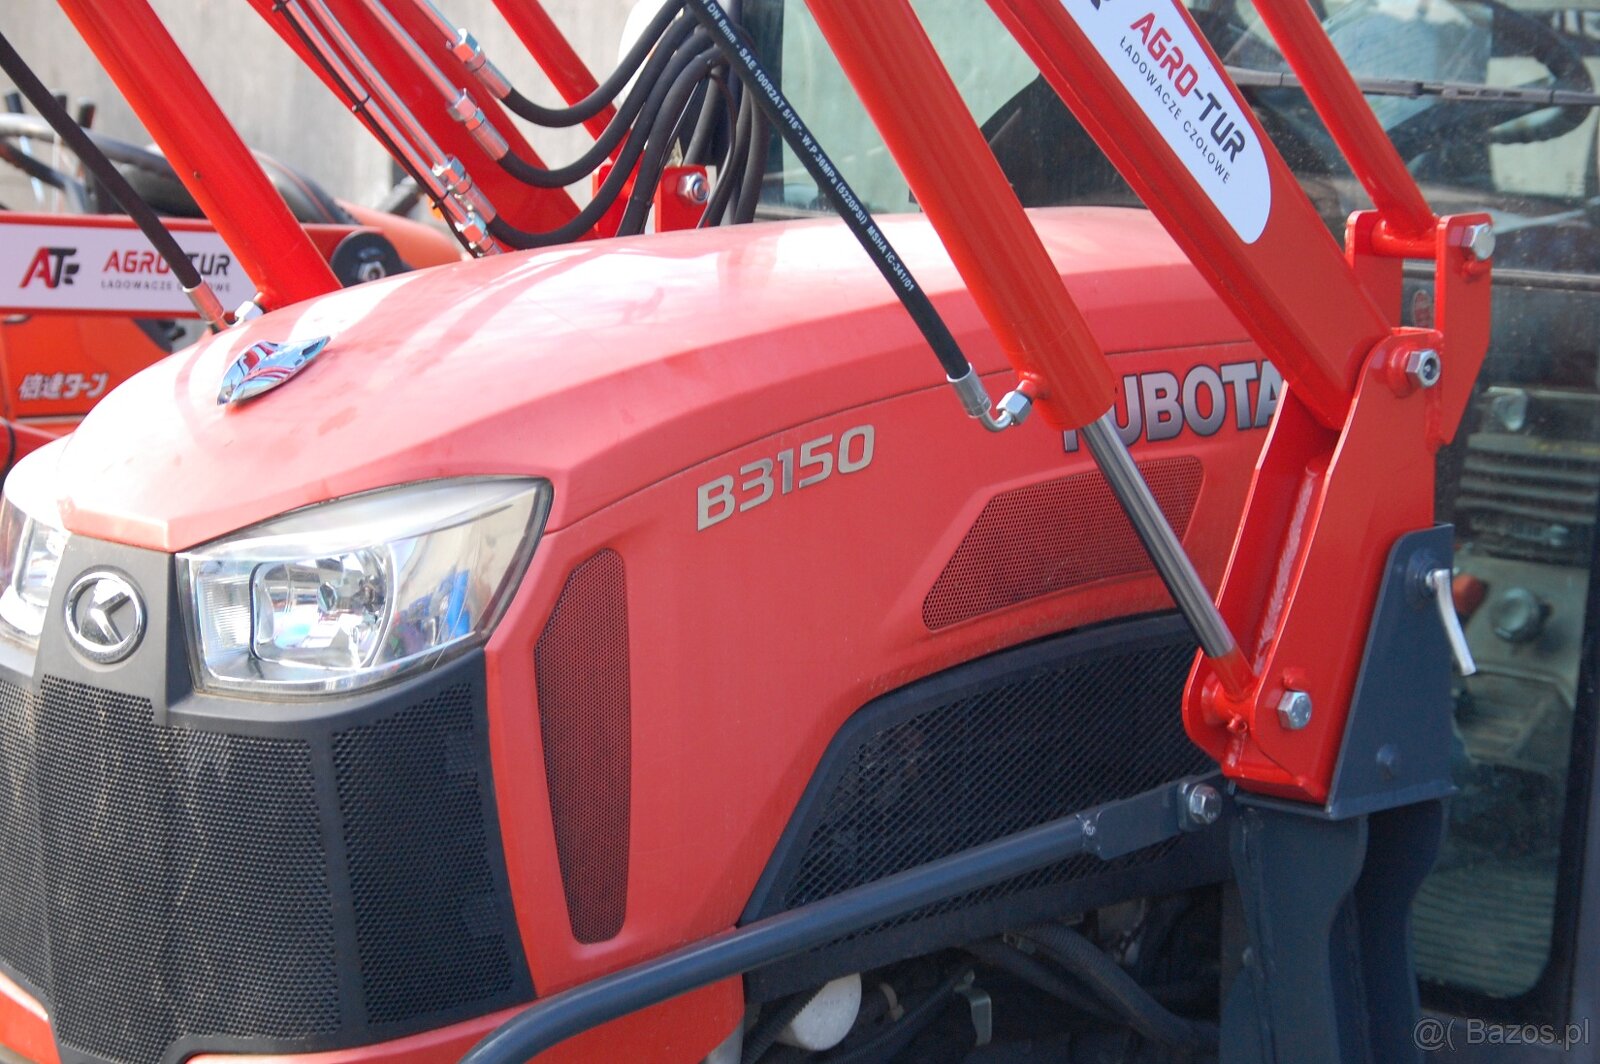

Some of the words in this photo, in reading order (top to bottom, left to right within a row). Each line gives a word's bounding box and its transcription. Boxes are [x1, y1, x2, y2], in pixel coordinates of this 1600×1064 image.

[707, 2, 721, 20] DN
[739, 48, 757, 70] SAE
[754, 69, 786, 110] 100R2AT
[836, 181, 868, 226] (5220PSI)
[866, 225, 887, 254] MSHA
[1119, 36, 1182, 121] ŁADOWACZE
[1183, 120, 1231, 184] CZOŁOWE
[1130, 12, 1246, 163] AGRO-TUR
[697, 423, 876, 532] B3150
[1063, 360, 1283, 452] UBOTA
